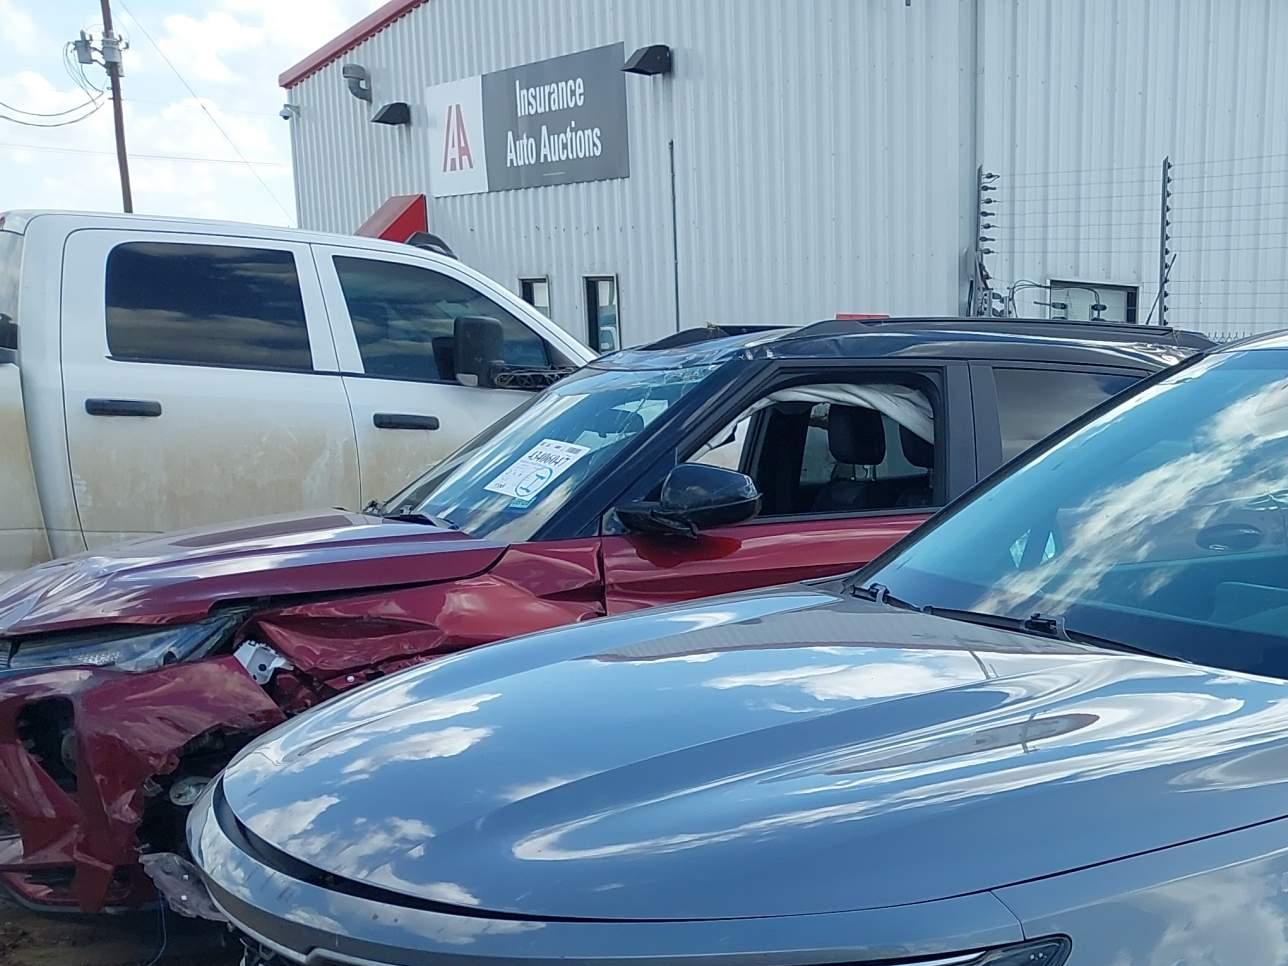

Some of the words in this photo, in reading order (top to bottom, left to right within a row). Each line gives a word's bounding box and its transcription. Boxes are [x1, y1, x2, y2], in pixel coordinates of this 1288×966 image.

[515, 77, 585, 118] Insurance
[506, 130, 537, 168] Auto
[540, 120, 602, 164] Auctions
